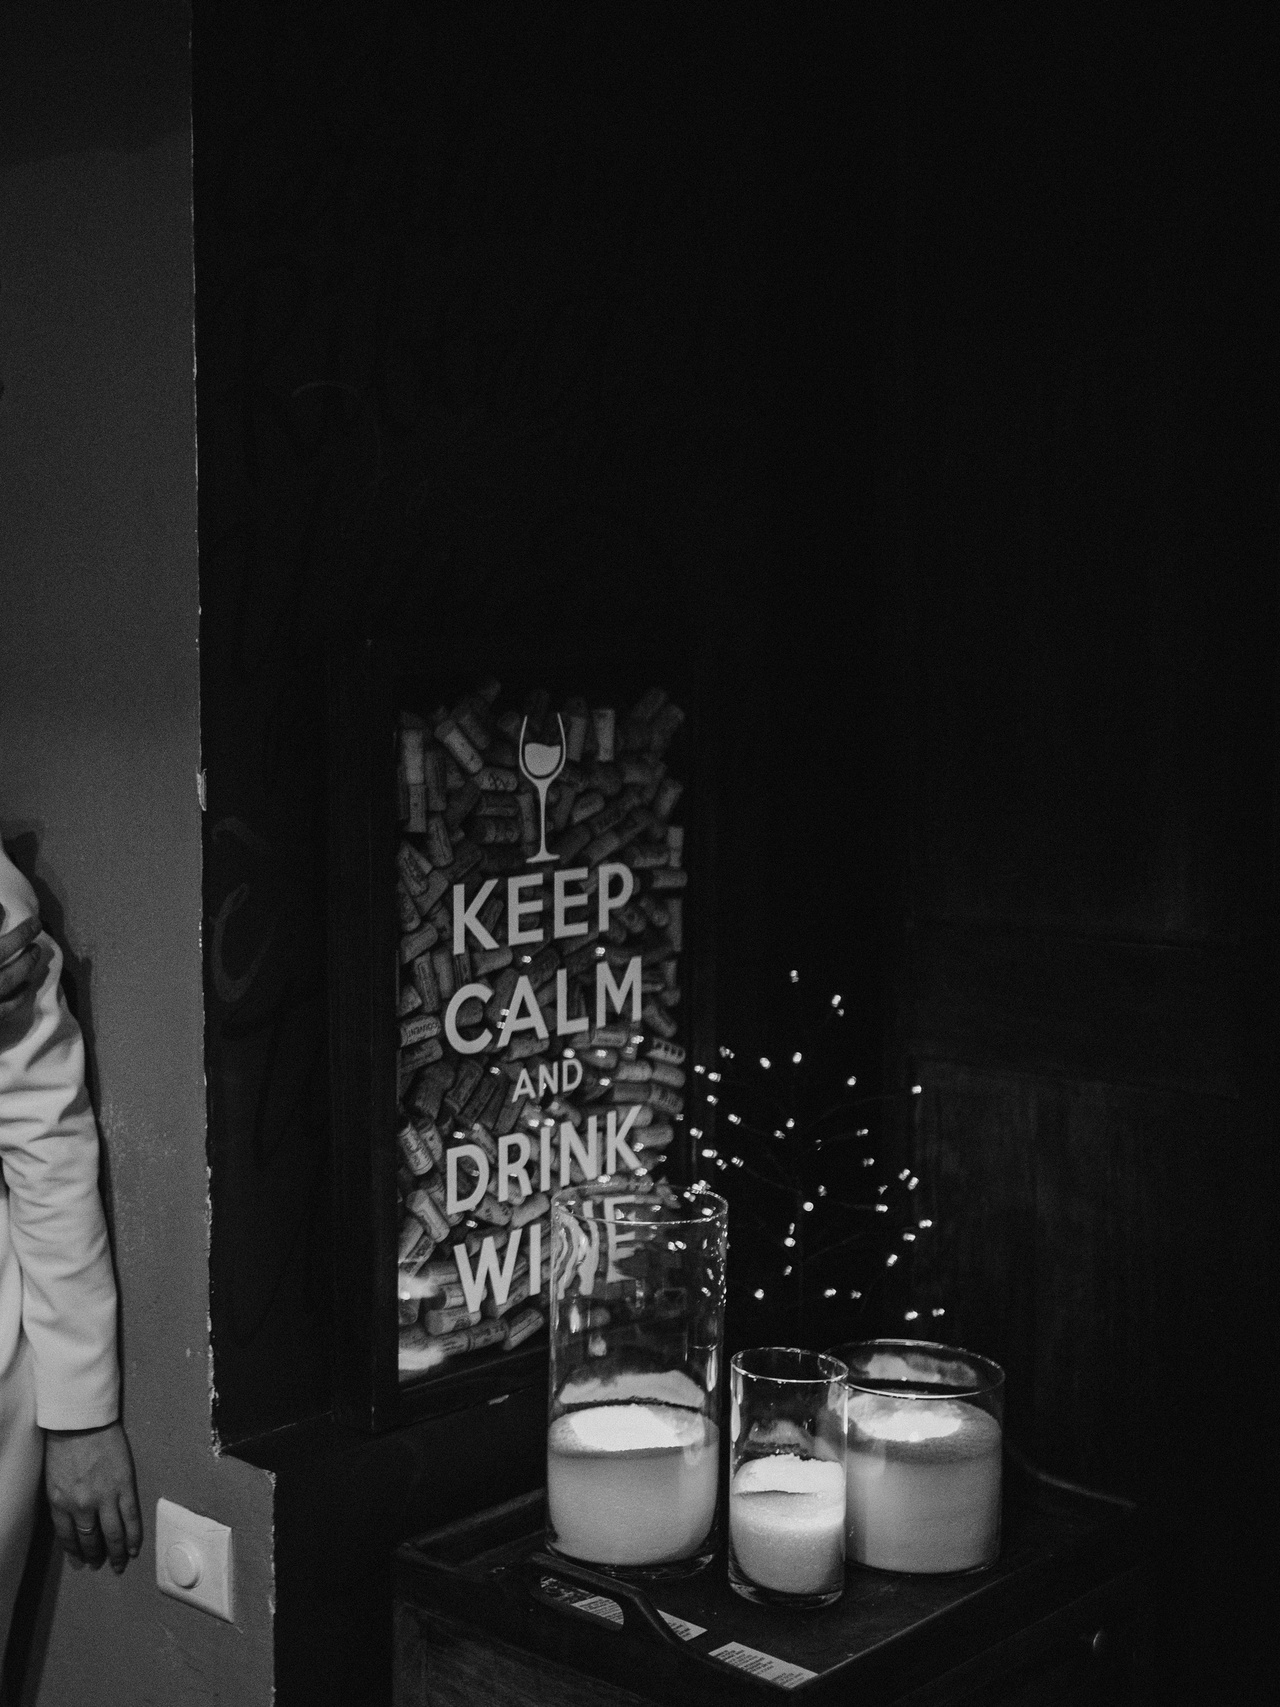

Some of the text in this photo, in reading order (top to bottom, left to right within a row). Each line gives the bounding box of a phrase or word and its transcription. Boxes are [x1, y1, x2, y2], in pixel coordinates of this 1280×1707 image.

[452, 863, 634, 956] KEEP
[444, 956, 642, 1055] CALM
[511, 1058, 583, 1103] AND
[446, 1105, 642, 1215] DRINK
[452, 1194, 637, 1314] WINE
